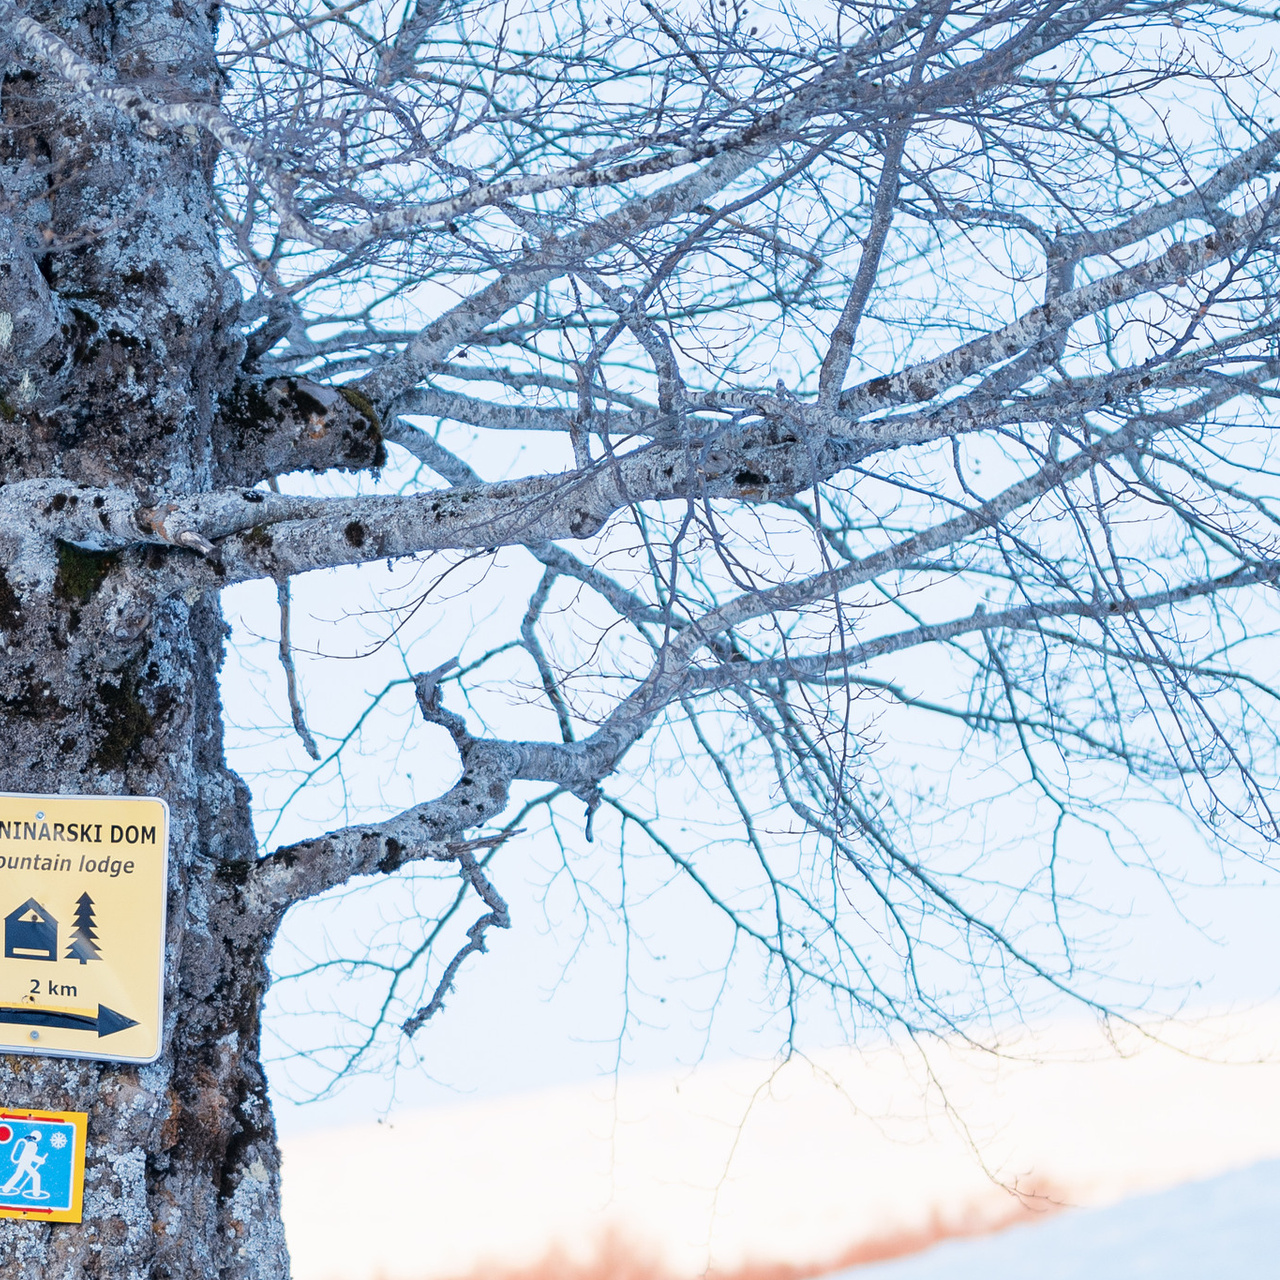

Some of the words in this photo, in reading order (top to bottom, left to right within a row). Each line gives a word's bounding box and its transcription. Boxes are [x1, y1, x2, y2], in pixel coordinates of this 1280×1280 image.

[110, 824, 157, 845] DOM
[78, 854, 135, 878] lodge
[29, 979, 41, 995] 2
[48, 980, 78, 997] km
